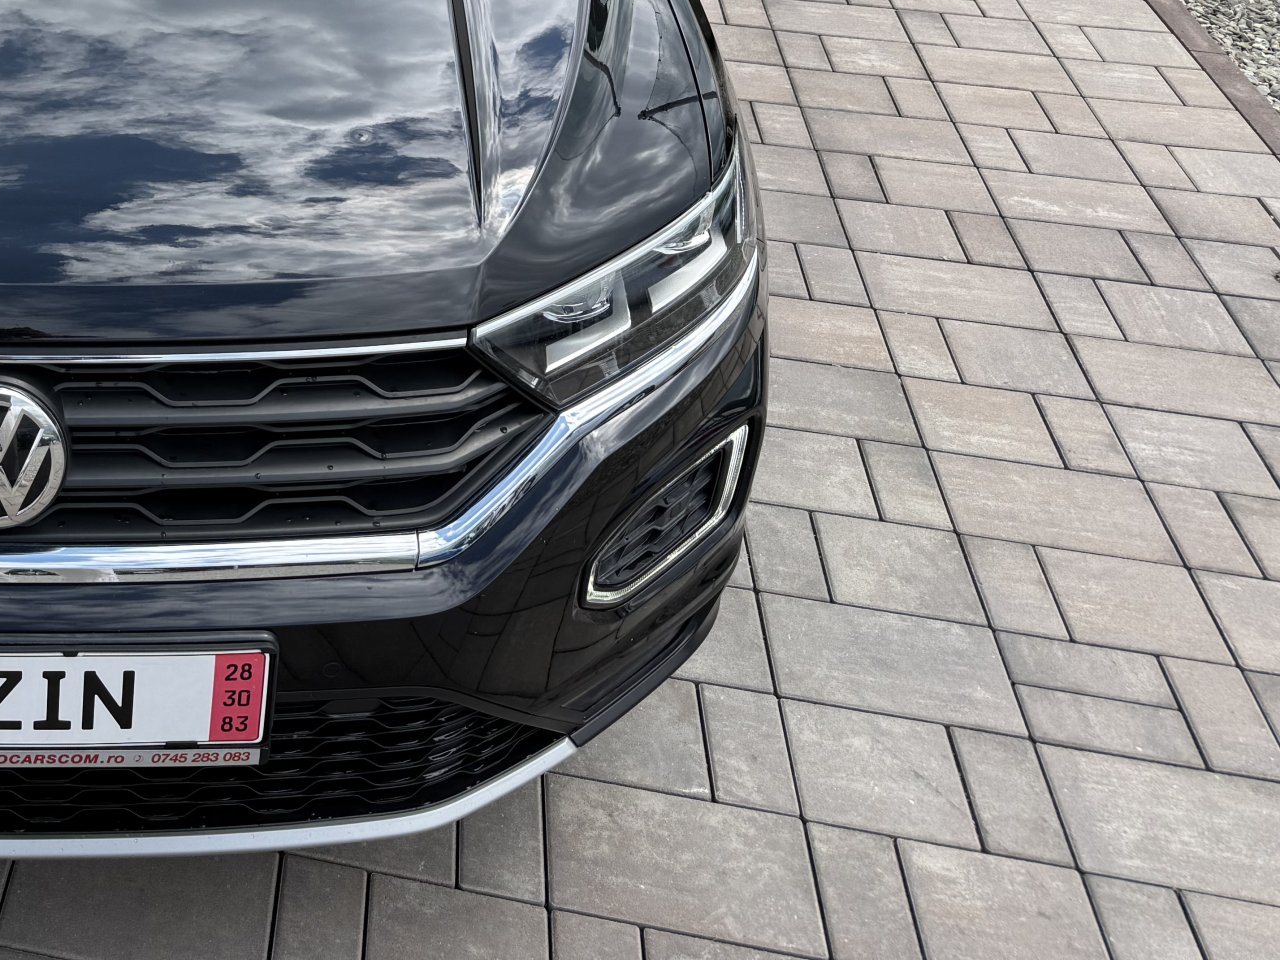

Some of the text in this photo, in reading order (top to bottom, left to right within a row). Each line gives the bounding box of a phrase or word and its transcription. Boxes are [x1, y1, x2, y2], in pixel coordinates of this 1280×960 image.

[224, 663, 253, 682] 28
[222, 690, 251, 708] 30
[220, 716, 249, 733] 83
[151, 753, 188, 764] 0745
[191, 752, 219, 763] 283
[223, 751, 251, 762] 083
